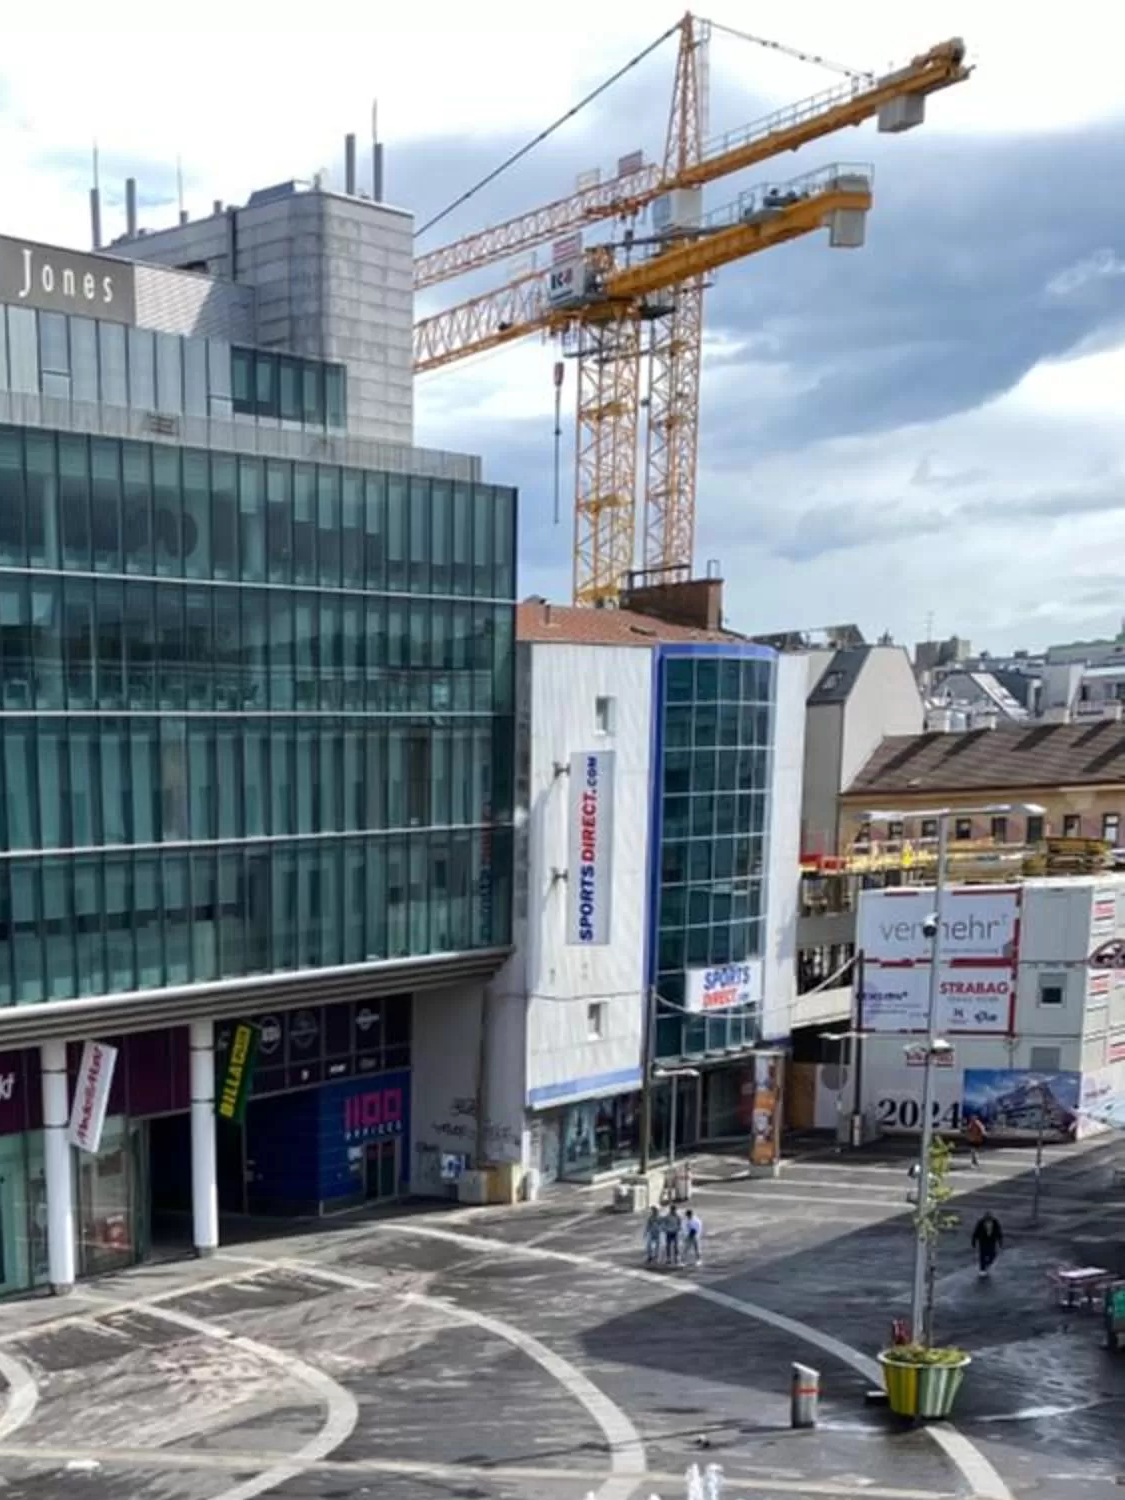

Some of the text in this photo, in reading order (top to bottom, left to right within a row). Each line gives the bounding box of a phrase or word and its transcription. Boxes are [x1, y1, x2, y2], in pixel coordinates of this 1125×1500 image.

[18, 249, 113, 302] Jones
[703, 965, 750, 991] SPORTS
[939, 981, 1009, 995] STRABAG
